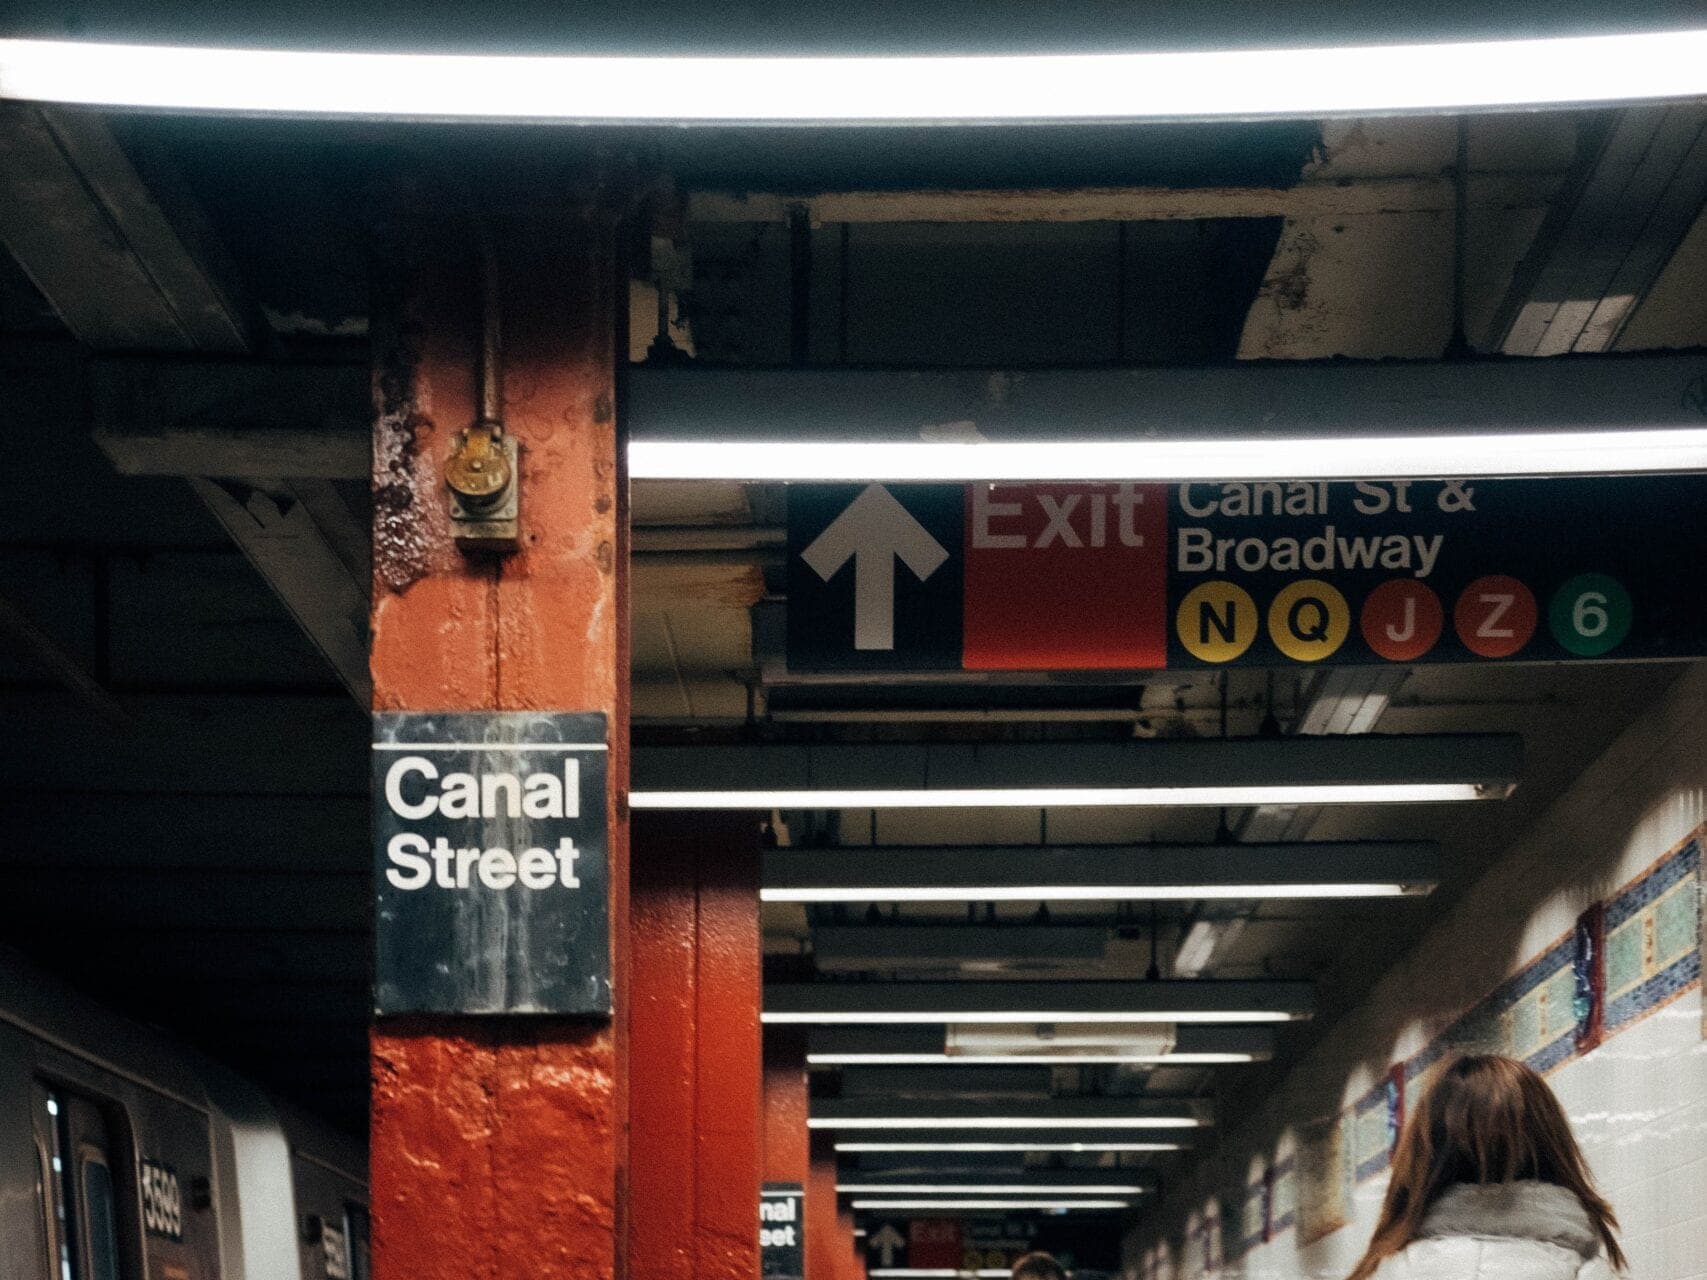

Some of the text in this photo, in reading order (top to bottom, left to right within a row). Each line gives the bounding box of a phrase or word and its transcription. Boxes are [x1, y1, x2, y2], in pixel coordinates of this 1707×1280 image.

[972, 484, 1145, 548] Exit
[1179, 479, 1477, 518] Canal St &
[1177, 525, 1444, 578] Broadway
[1200, 592, 1608, 644] N Q J Z 6
[385, 756, 580, 820] Canal
[385, 832, 581, 890] Street
[759, 1197, 796, 1221] nal
[759, 1225, 796, 1247] eet
